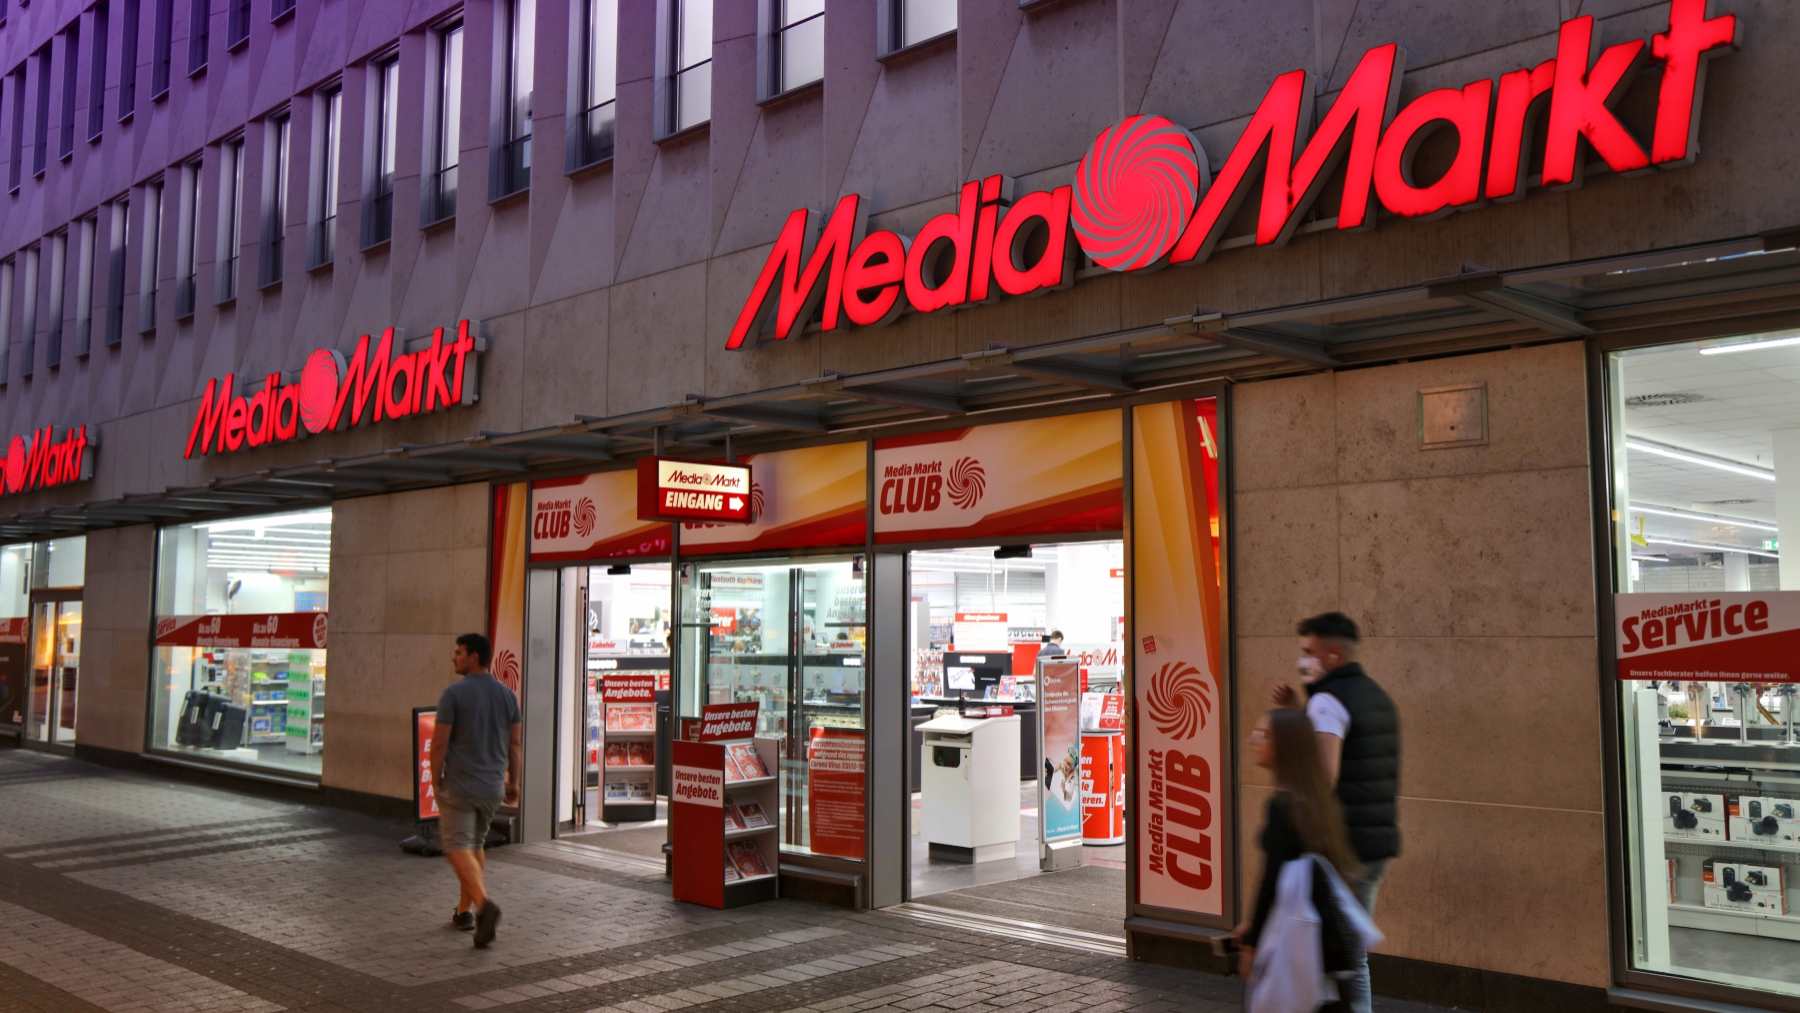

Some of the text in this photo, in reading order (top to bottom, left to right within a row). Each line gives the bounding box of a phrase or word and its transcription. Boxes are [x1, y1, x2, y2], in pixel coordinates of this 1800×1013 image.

[726, 0, 1737, 349] Media Markt
[184, 319, 475, 459] Media Markt
[18, 423, 86, 493] Markt
[884, 460, 942, 477] Media Markt
[668, 470, 741, 488] Media Markt
[537, 499, 571, 511] Media Markt
[665, 491, 723, 511] EINGANG
[880, 475, 942, 515] CLUB
[534, 510, 571, 539] CLUB
[1641, 599, 1708, 620] MediaMarkt
[1622, 599, 1768, 653] Service
[604, 679, 653, 688] Unsere besten
[605, 687, 652, 699] Angebote.
[705, 708, 757, 721] Unsere besten
[703, 720, 752, 736] Angebote.
[675, 770, 721, 785] Unsere besten
[676, 783, 720, 801] Angebote.
[1147, 748, 1164, 876] Media Markt
[1165, 749, 1212, 890] CLUB
